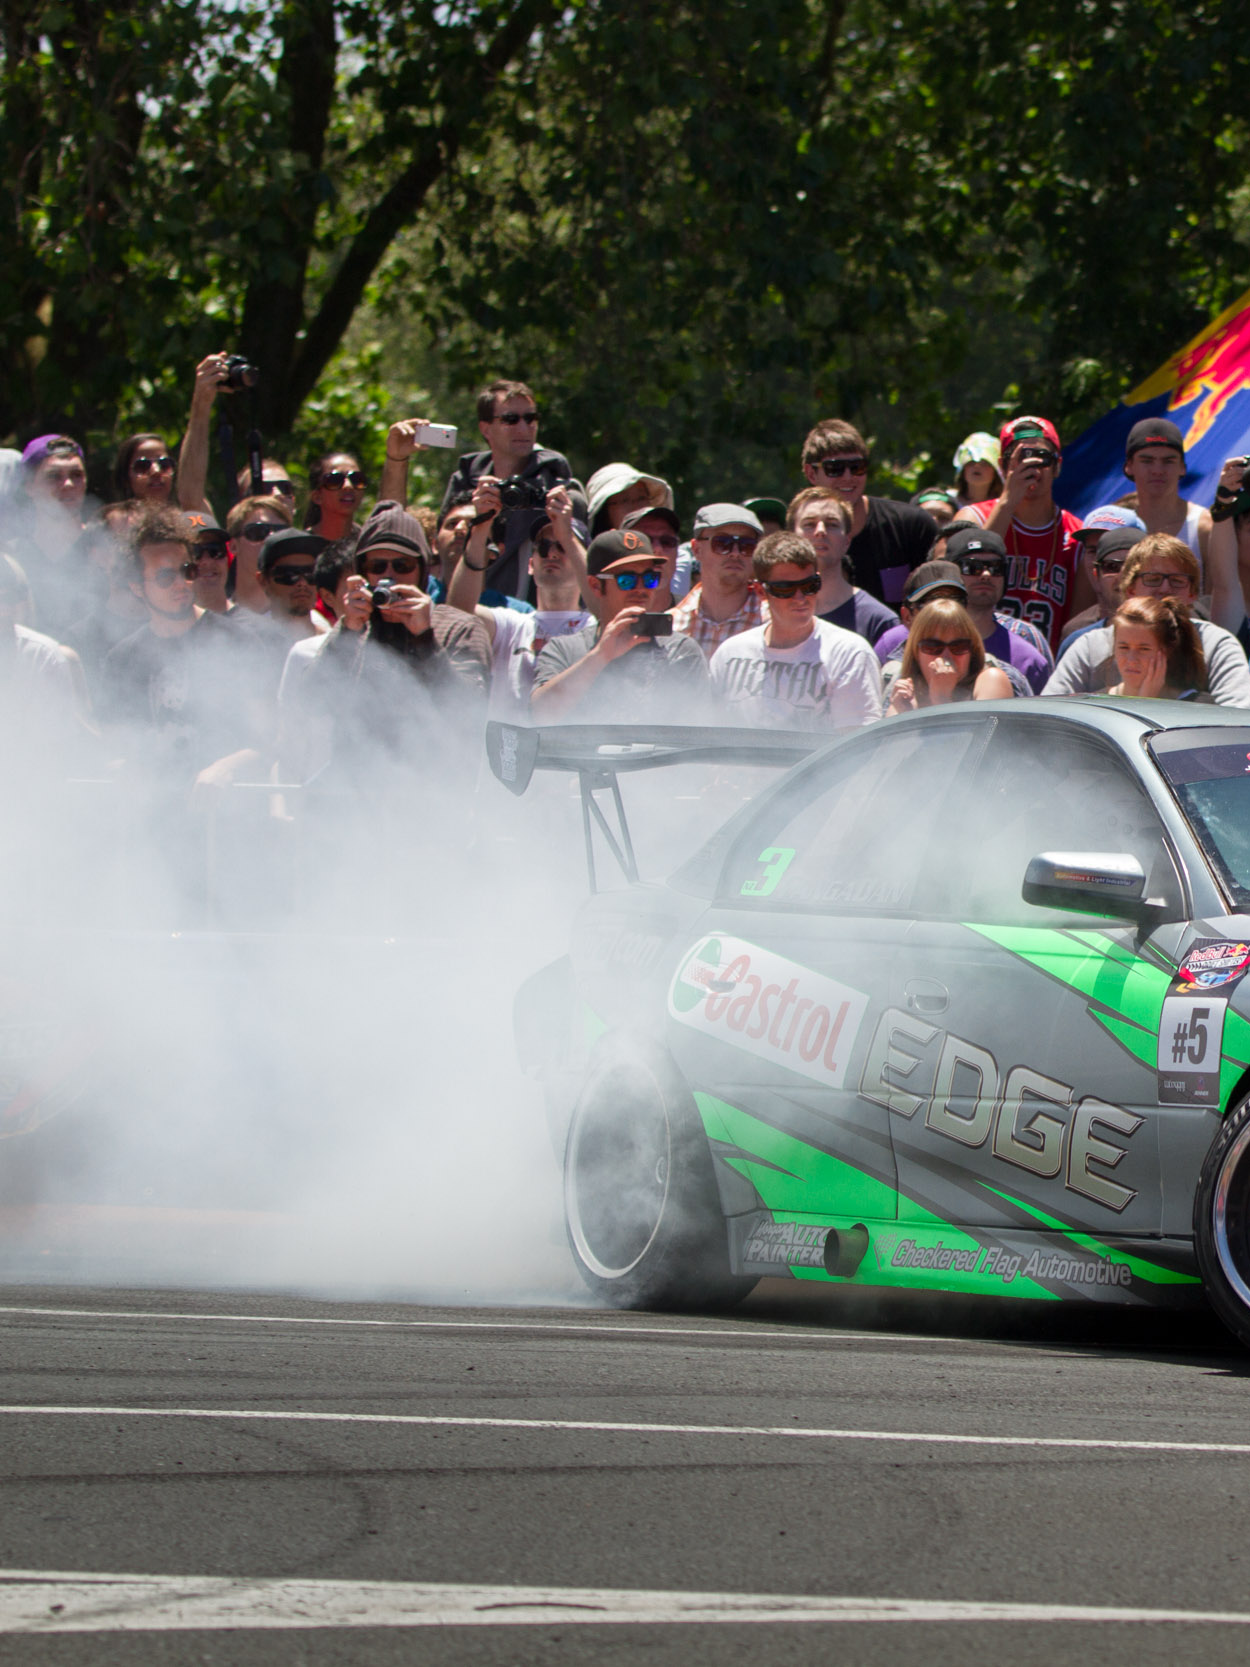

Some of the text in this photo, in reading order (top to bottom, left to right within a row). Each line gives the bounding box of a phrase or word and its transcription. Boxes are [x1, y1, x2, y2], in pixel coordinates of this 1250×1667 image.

[1005, 555, 1067, 607] ULLS
[740, 847, 796, 896] 3
[704, 954, 851, 1072] Castrol
[1171, 1007, 1210, 1065] #5
[857, 1007, 1147, 1214] EDGE
[746, 1239, 825, 1267] PAINTER
[891, 1239, 1132, 1286] Checkered Flag Automotive
